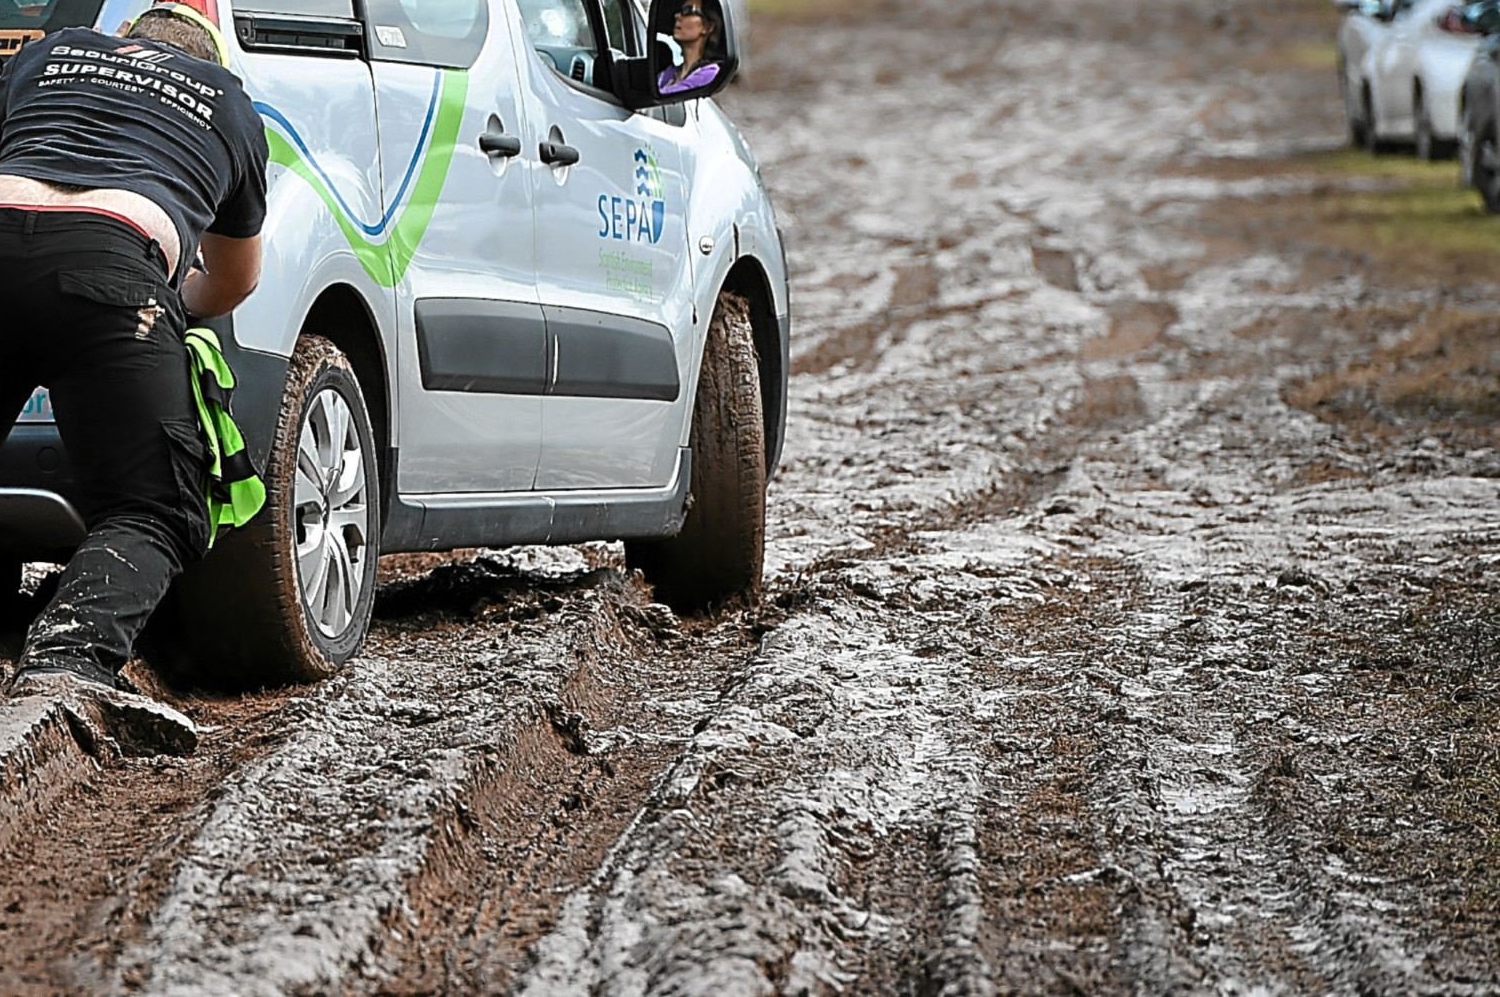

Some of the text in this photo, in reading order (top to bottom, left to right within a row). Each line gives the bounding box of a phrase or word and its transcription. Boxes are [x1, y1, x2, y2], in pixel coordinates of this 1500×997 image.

[38, 77, 213, 132] SAFETY COURTESY EFFICIENCY
[43, 63, 214, 121] SUPERVISOR
[598, 194, 653, 244] SEPA
